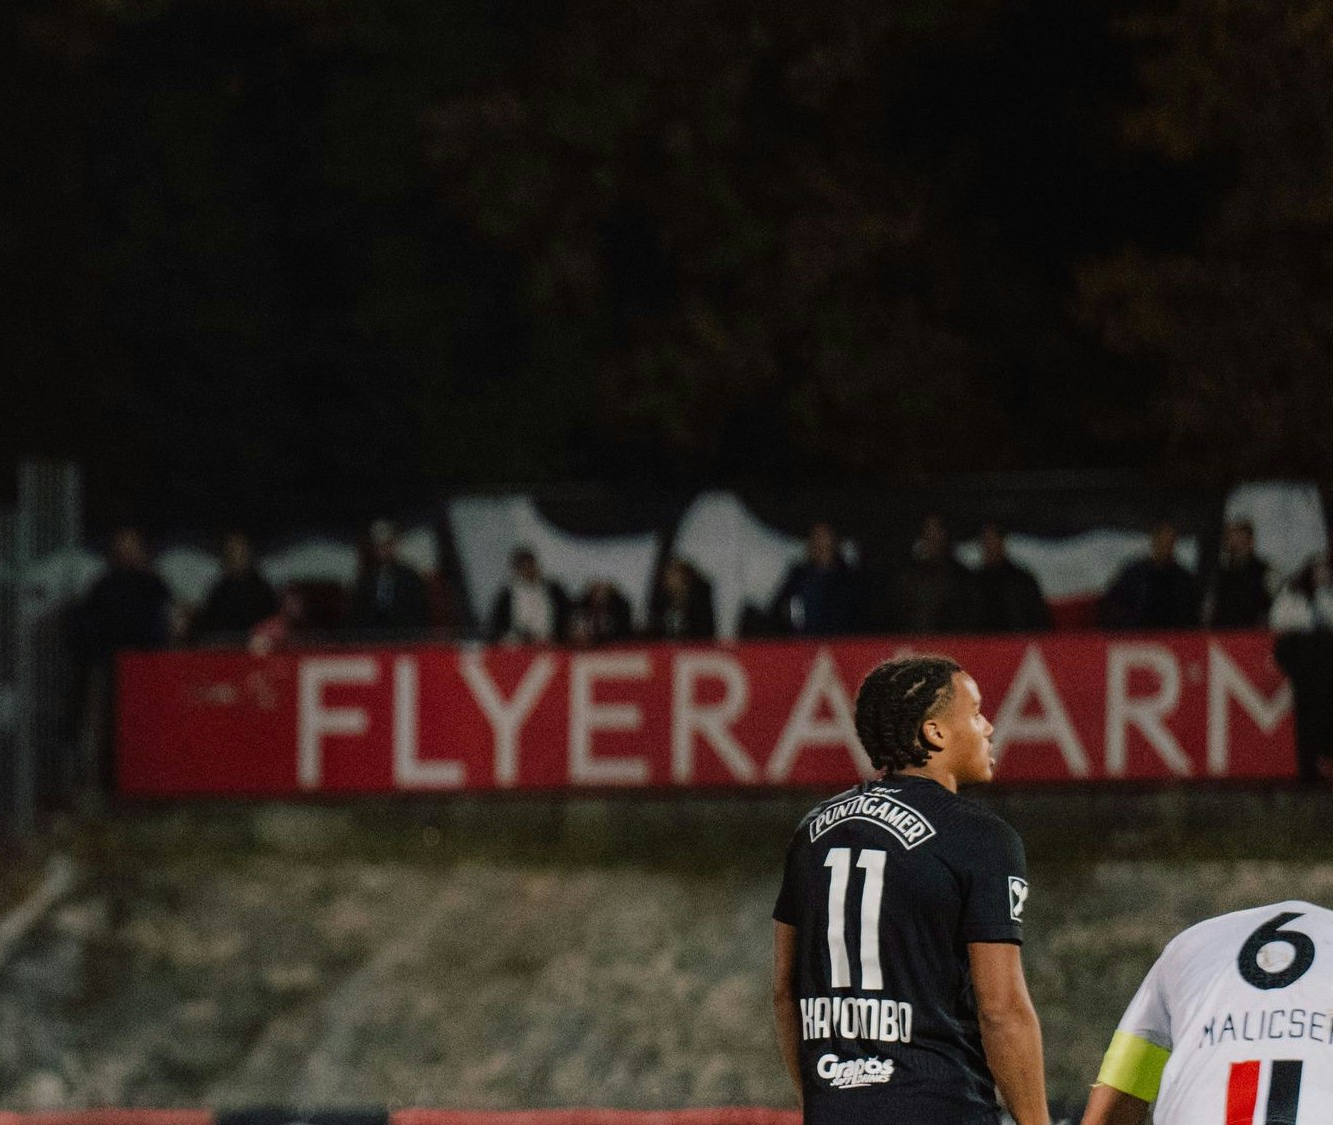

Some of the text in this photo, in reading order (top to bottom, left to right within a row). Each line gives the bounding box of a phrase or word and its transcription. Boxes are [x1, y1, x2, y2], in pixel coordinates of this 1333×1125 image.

[296, 640, 1294, 790] FLYERAARM
[815, 797, 925, 843] PUNTIGAMER
[823, 847, 887, 990] 11
[1237, 911, 1316, 990] 6
[1199, 1009, 1333, 1048] ALICSE
